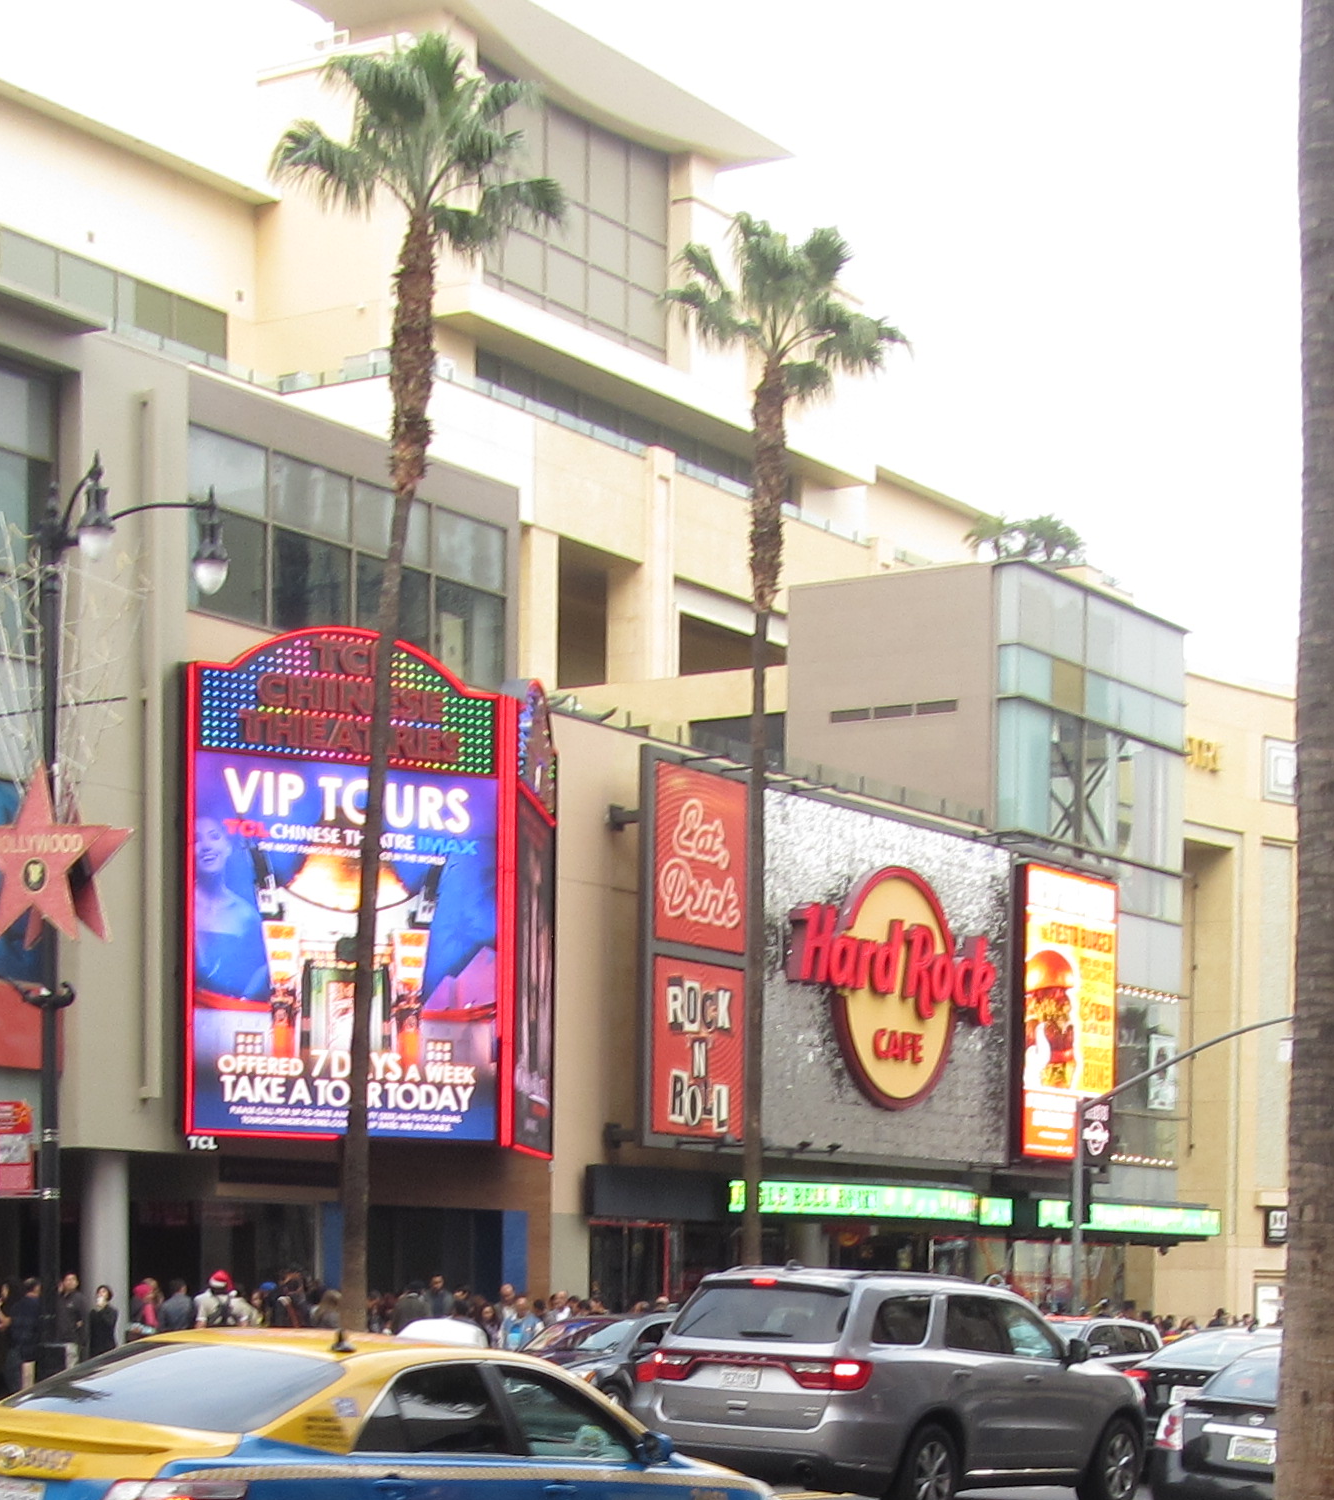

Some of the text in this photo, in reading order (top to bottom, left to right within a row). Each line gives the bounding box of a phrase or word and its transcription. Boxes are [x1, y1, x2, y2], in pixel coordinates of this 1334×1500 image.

[223, 767, 305, 818] VIP
[269, 822, 341, 846] CHINESE
[789, 902, 996, 1026] Hard Rock
[667, 976, 732, 1033] ROCK
[872, 1028, 924, 1064] CAFE
[217, 1049, 476, 1085] OFFERED 7 DYS A WEEK
[220, 1075, 475, 1112] TAKE A TOR TODAY
[187, 1136, 218, 1151] TCL
